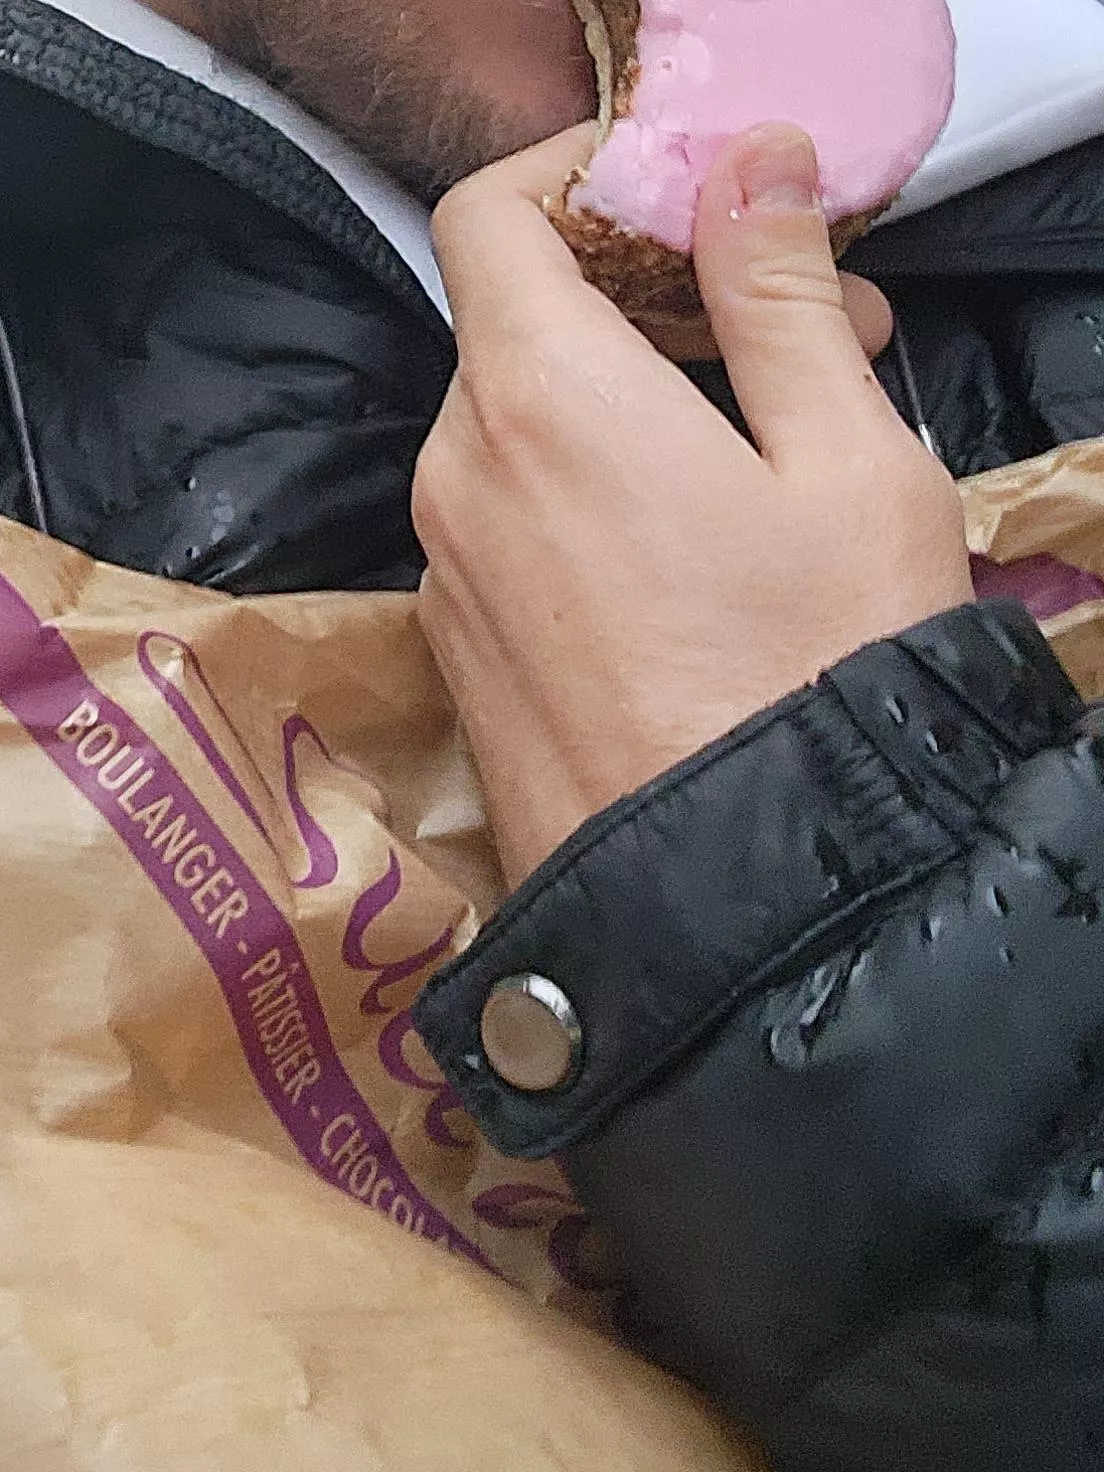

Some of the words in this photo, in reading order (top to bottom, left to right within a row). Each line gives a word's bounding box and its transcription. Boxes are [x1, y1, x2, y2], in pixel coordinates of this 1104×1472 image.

[57, 699, 249, 939] BOULANGER
[242, 947, 321, 1105] PÂTISSIER
[320, 1113, 449, 1246] CHOCO
